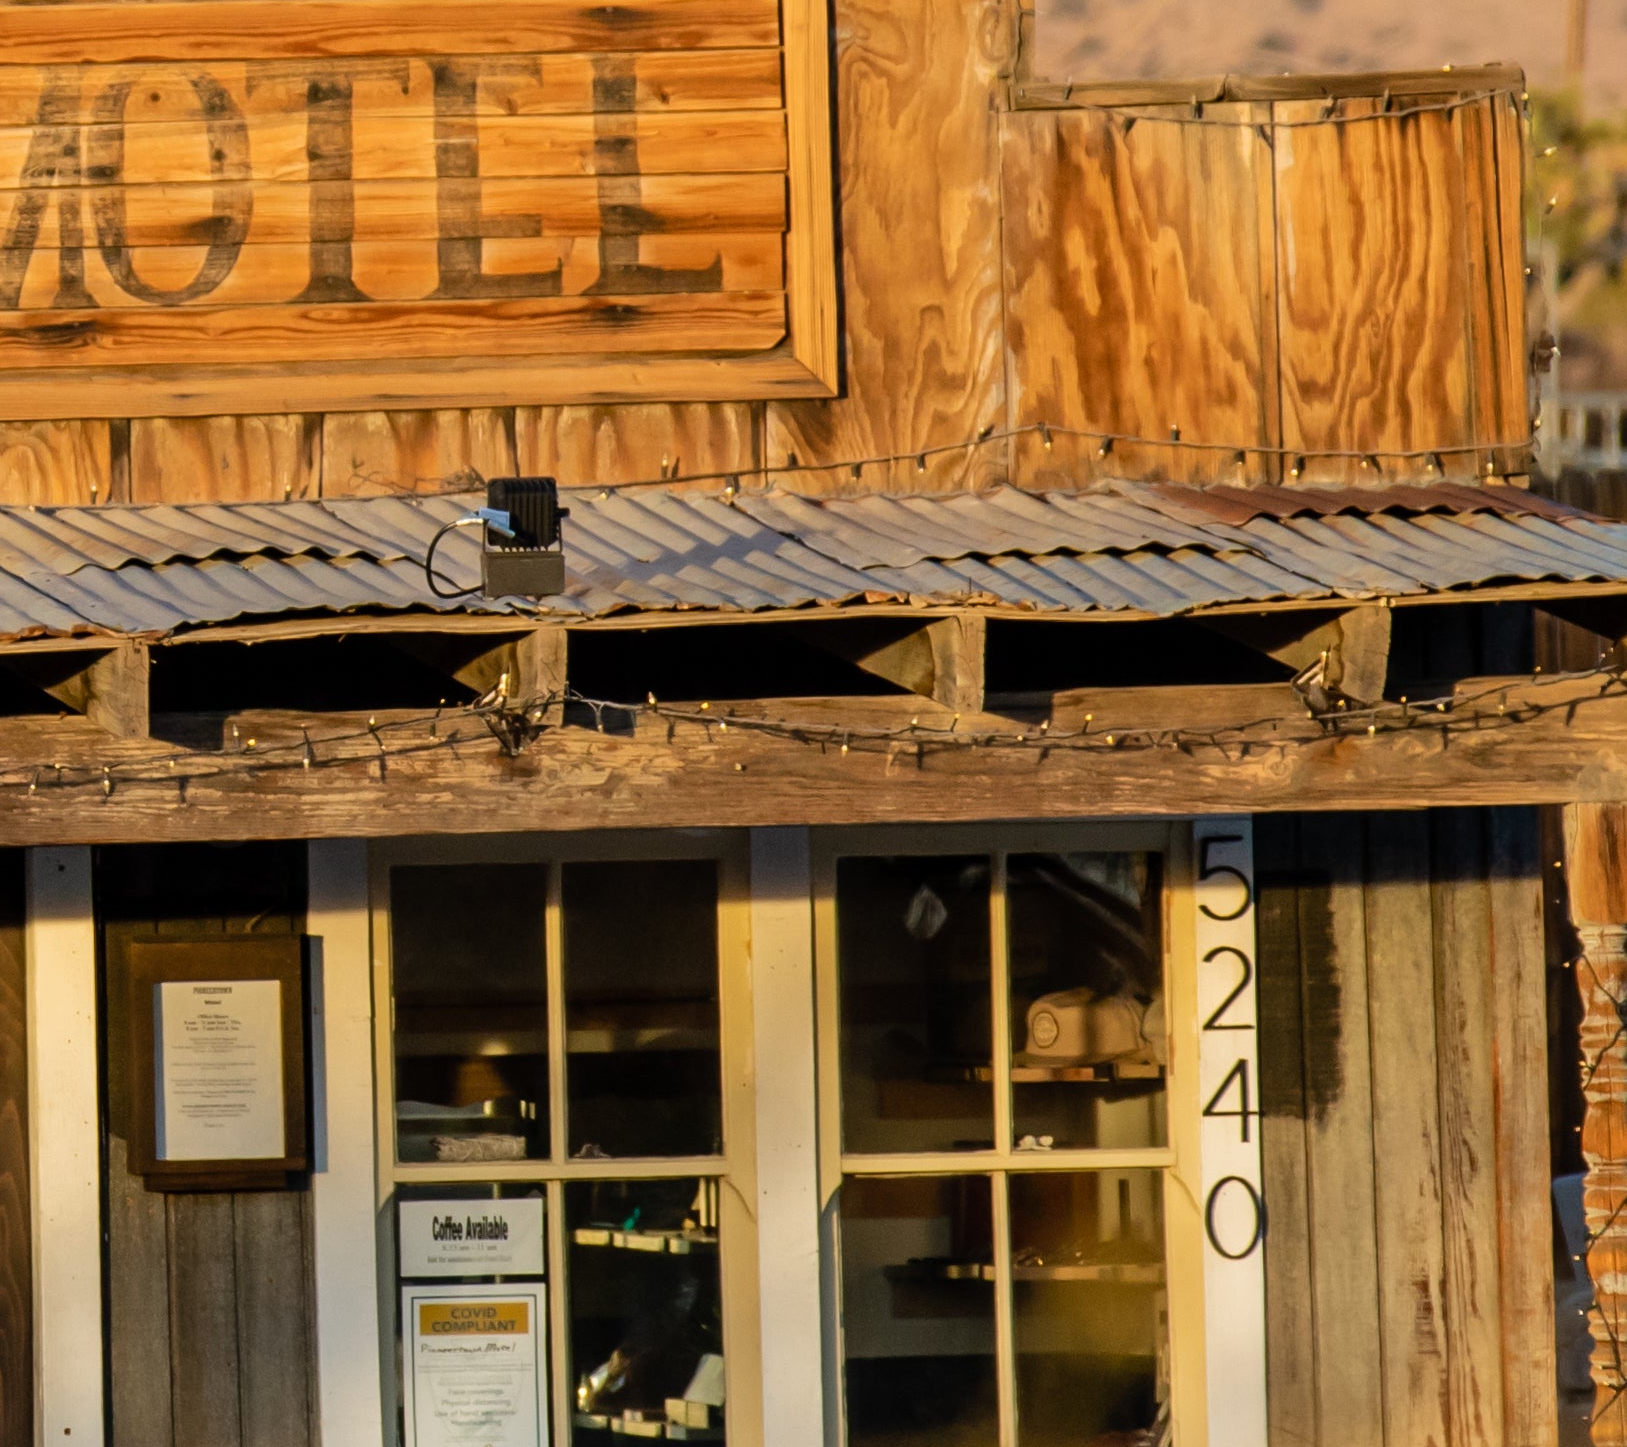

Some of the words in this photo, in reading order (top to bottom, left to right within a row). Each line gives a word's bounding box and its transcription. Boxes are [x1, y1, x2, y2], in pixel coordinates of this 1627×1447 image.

[1197, 834, 1267, 1260] 5240
[432, 1215, 463, 1241] Coffee
[465, 1215, 509, 1241] Available
[450, 1307, 497, 1319] COVID
[431, 1320, 516, 1332] COMPLIANT
